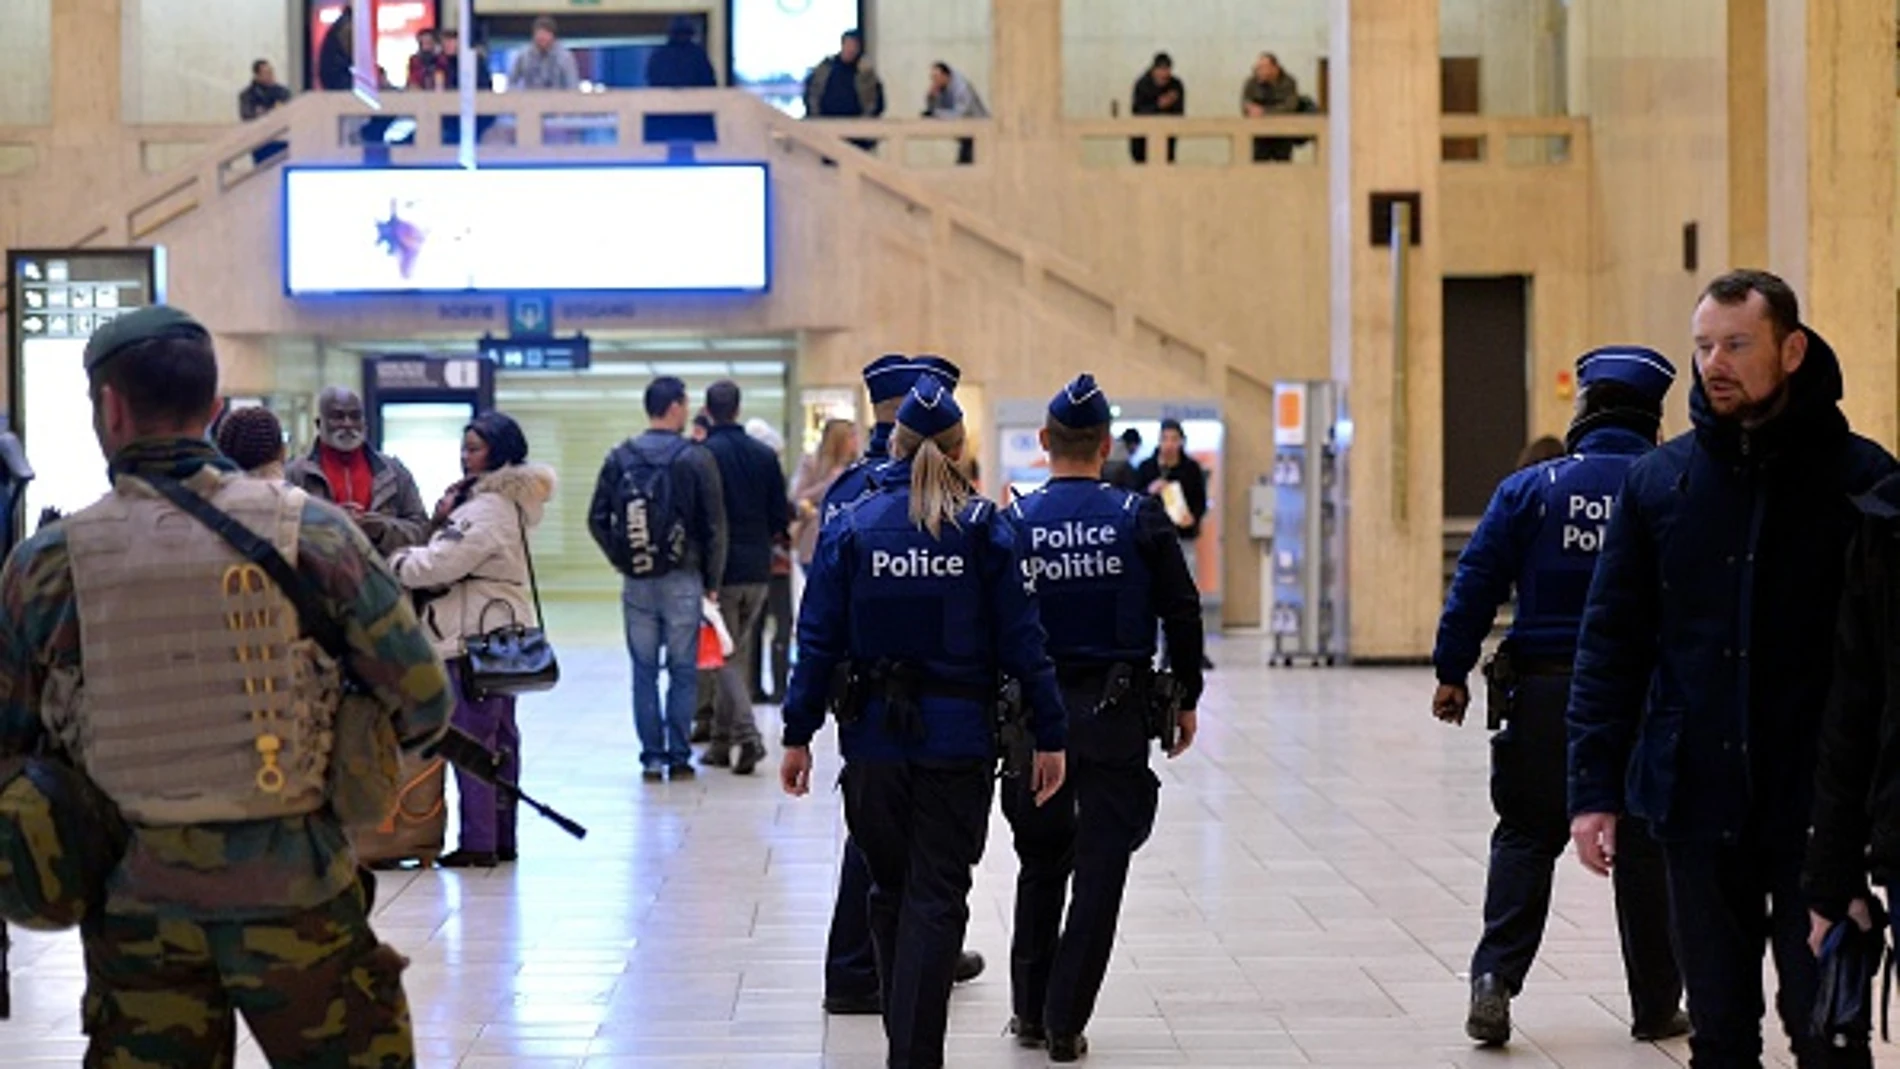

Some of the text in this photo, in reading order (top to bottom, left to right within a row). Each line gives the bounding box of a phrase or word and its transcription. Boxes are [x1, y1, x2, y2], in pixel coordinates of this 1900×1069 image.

[1569, 494, 1620, 520] Pol
[1031, 521, 1118, 550] Police
[1562, 524, 1606, 552] Pol
[871, 549, 965, 578] Police
[1031, 551, 1124, 581] Politie
